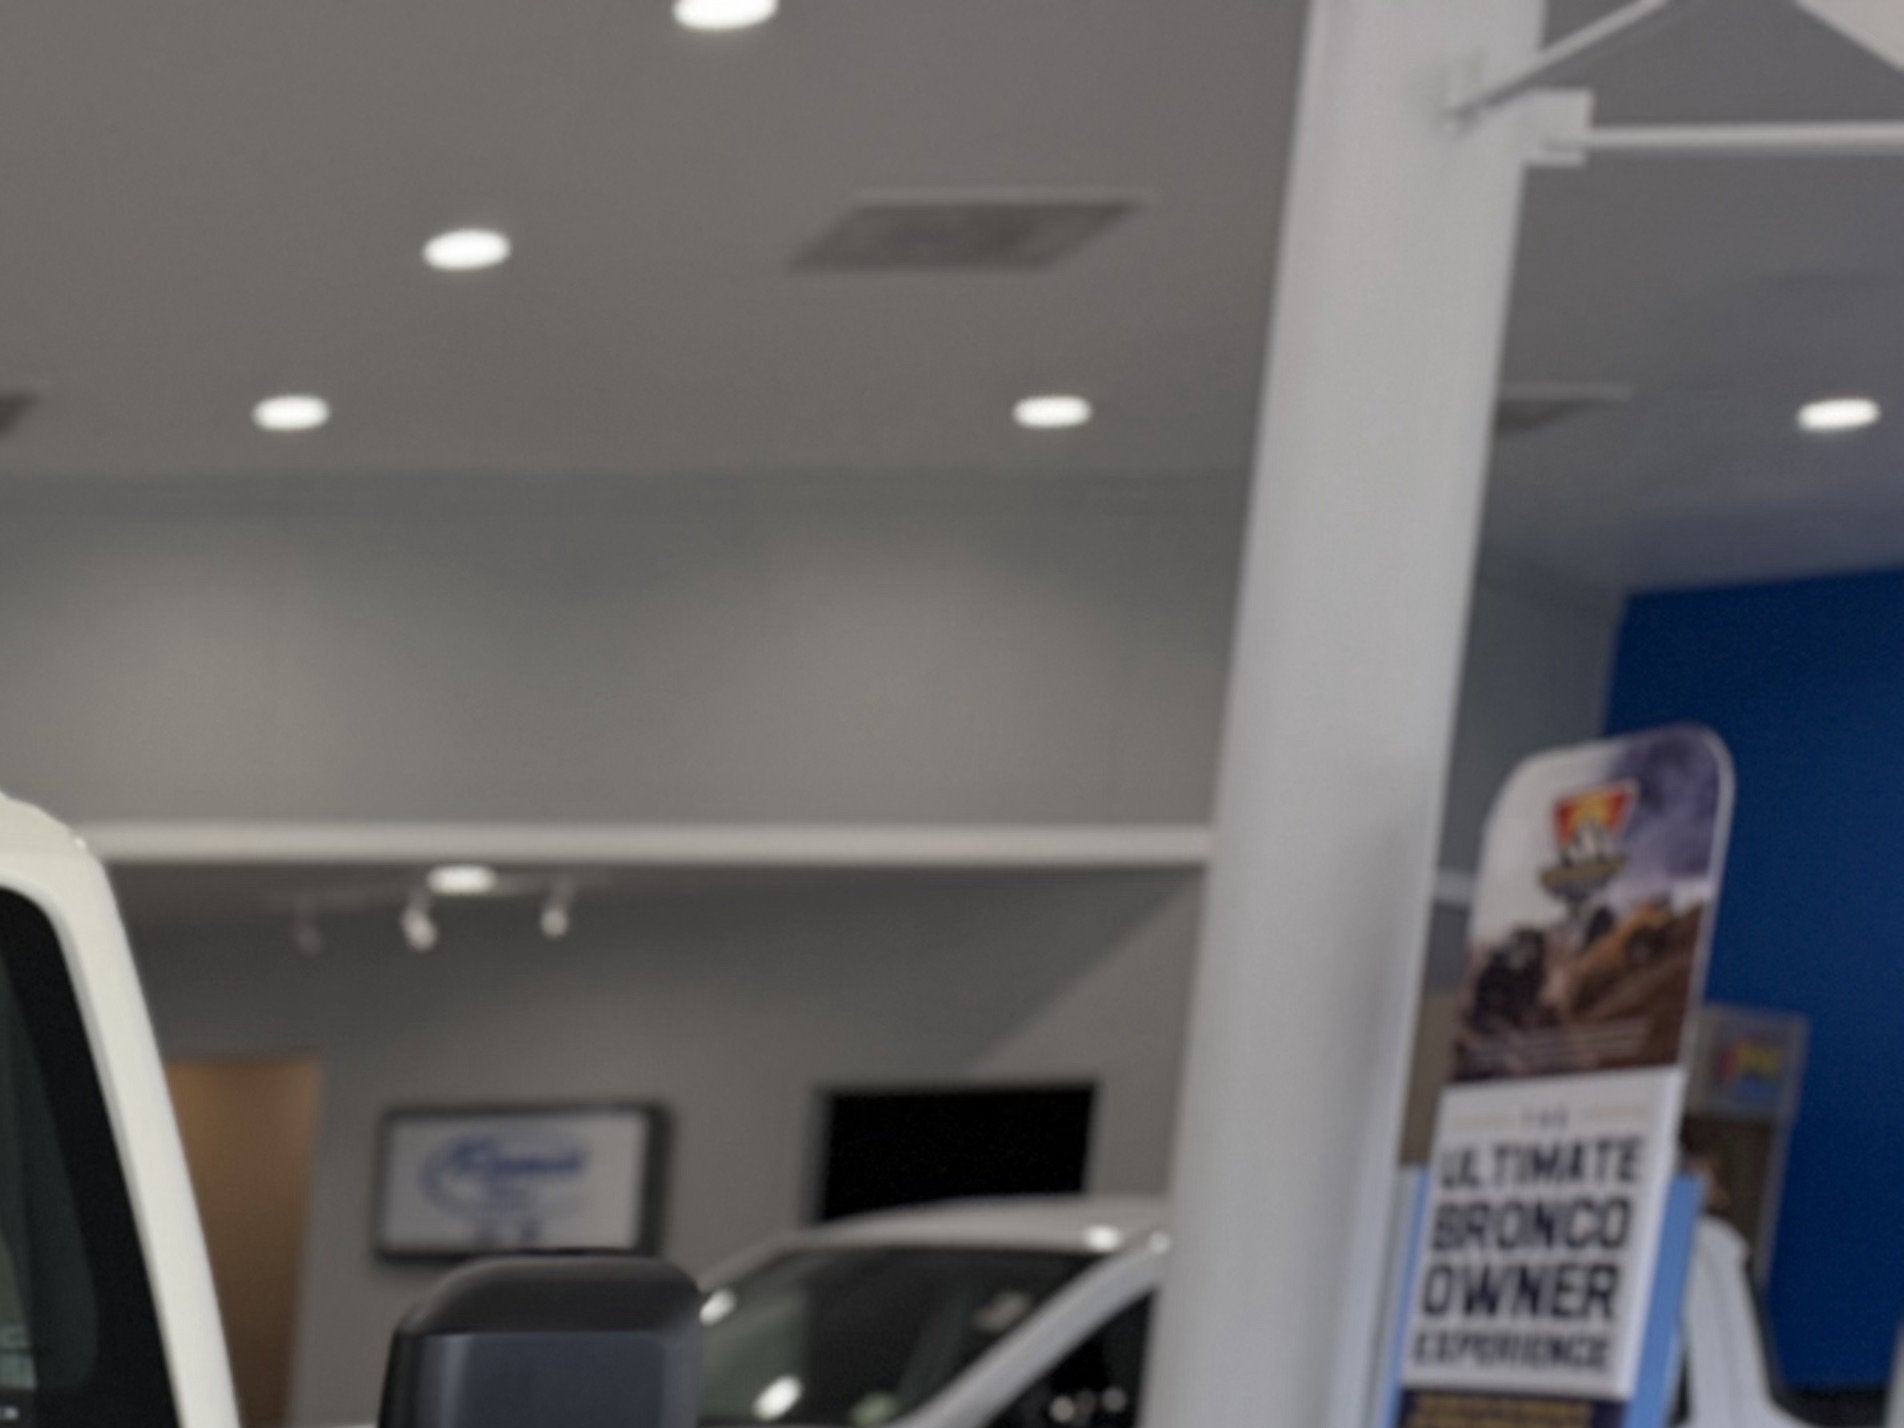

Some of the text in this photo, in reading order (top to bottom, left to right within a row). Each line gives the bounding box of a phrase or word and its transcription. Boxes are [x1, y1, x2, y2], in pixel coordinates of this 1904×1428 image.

[1440, 1137, 1644, 1188] ULTIMATE
[1432, 1196, 1632, 1250] BRONCO
[1422, 1263, 1618, 1320] OWNER
[1412, 1331, 1610, 1367] EXPERIENCE
